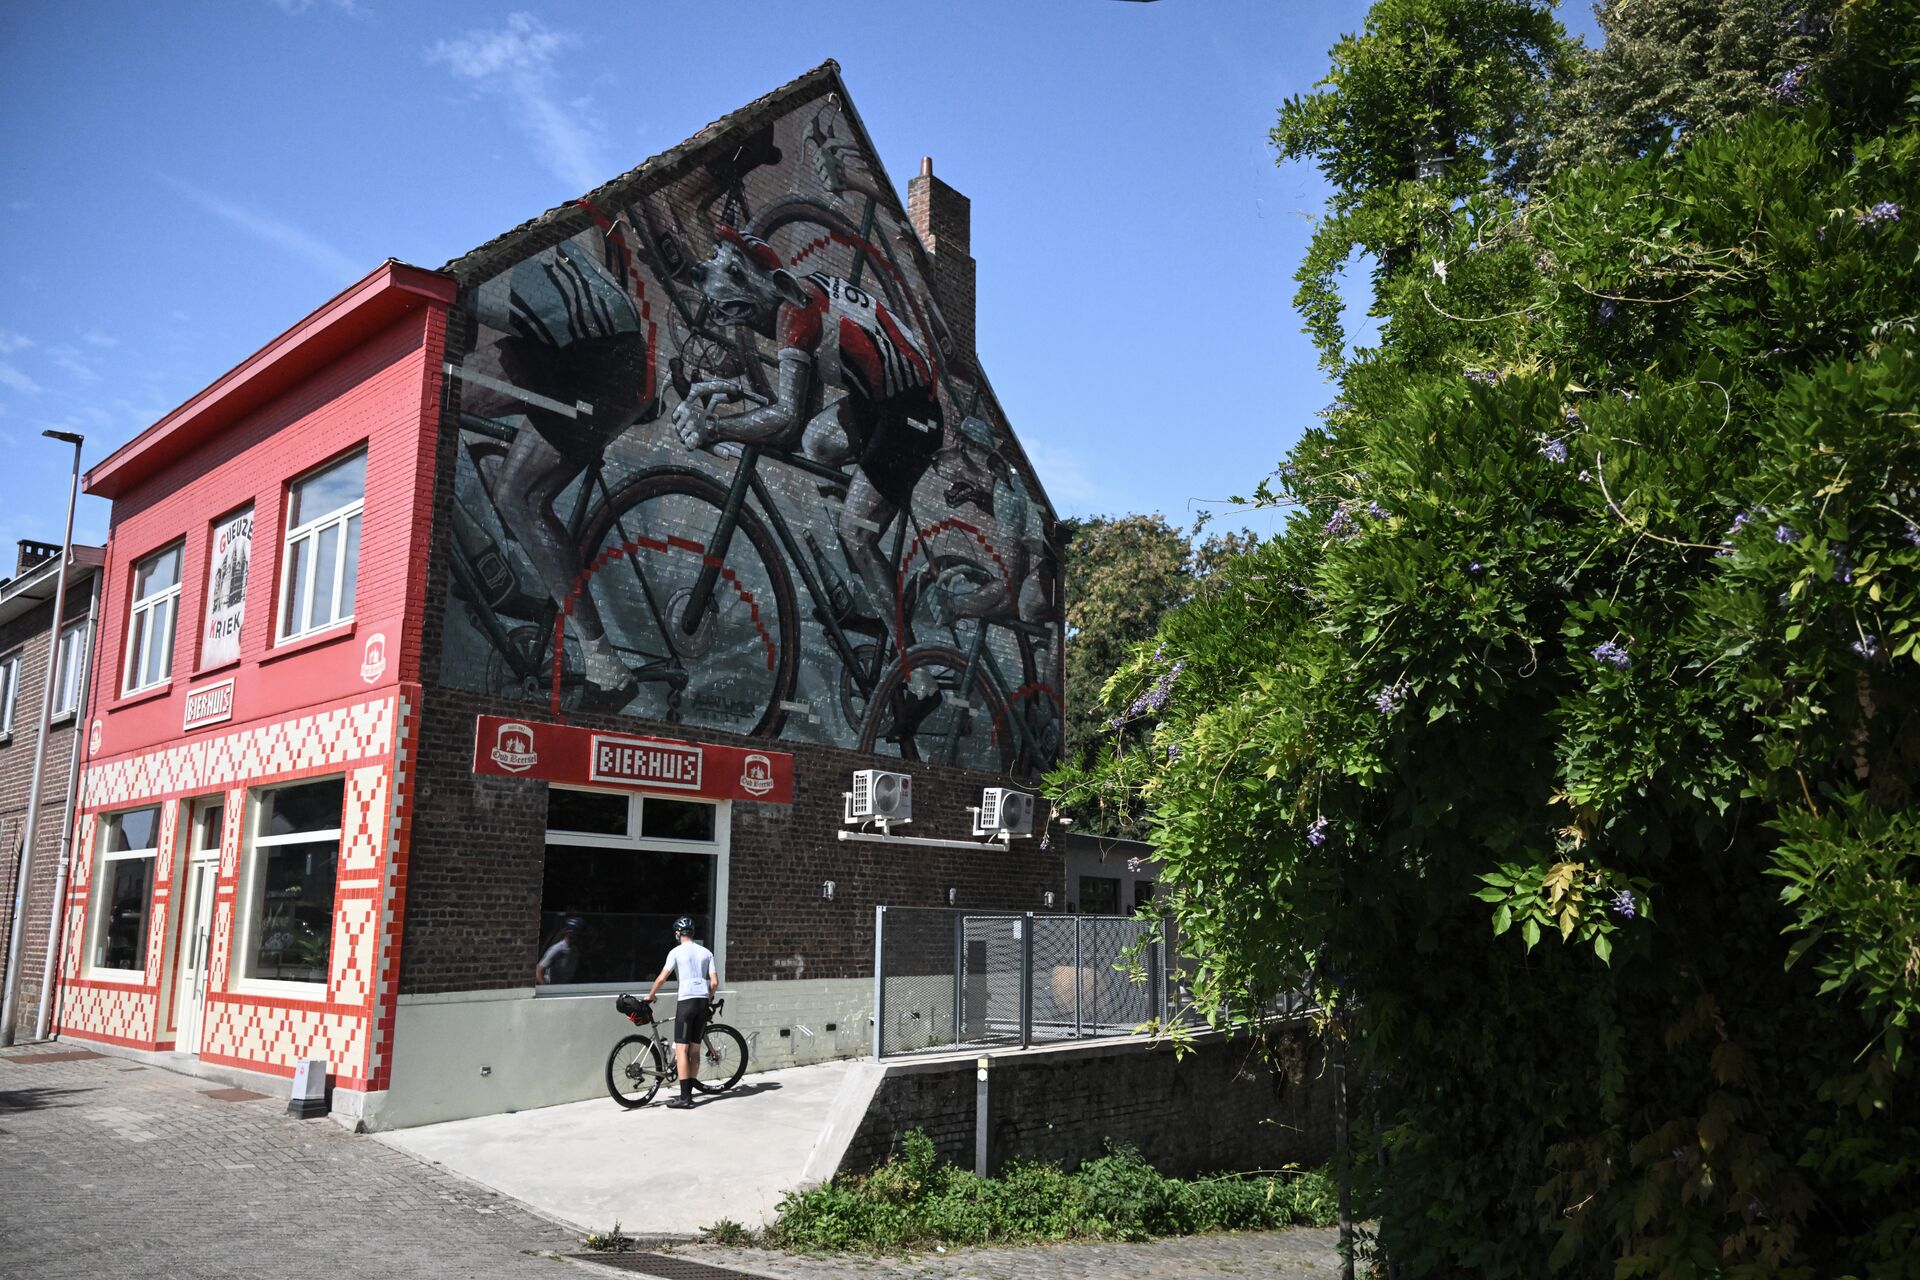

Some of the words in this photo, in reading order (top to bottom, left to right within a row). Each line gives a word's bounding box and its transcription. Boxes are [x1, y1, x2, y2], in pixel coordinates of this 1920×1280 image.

[220, 518, 254, 553] GUEUZE
[208, 611, 242, 640] KRIEK
[186, 687, 231, 722] BIERHUIS
[493, 750, 508, 762] Oud
[599, 746, 696, 781] BIERHUIS
